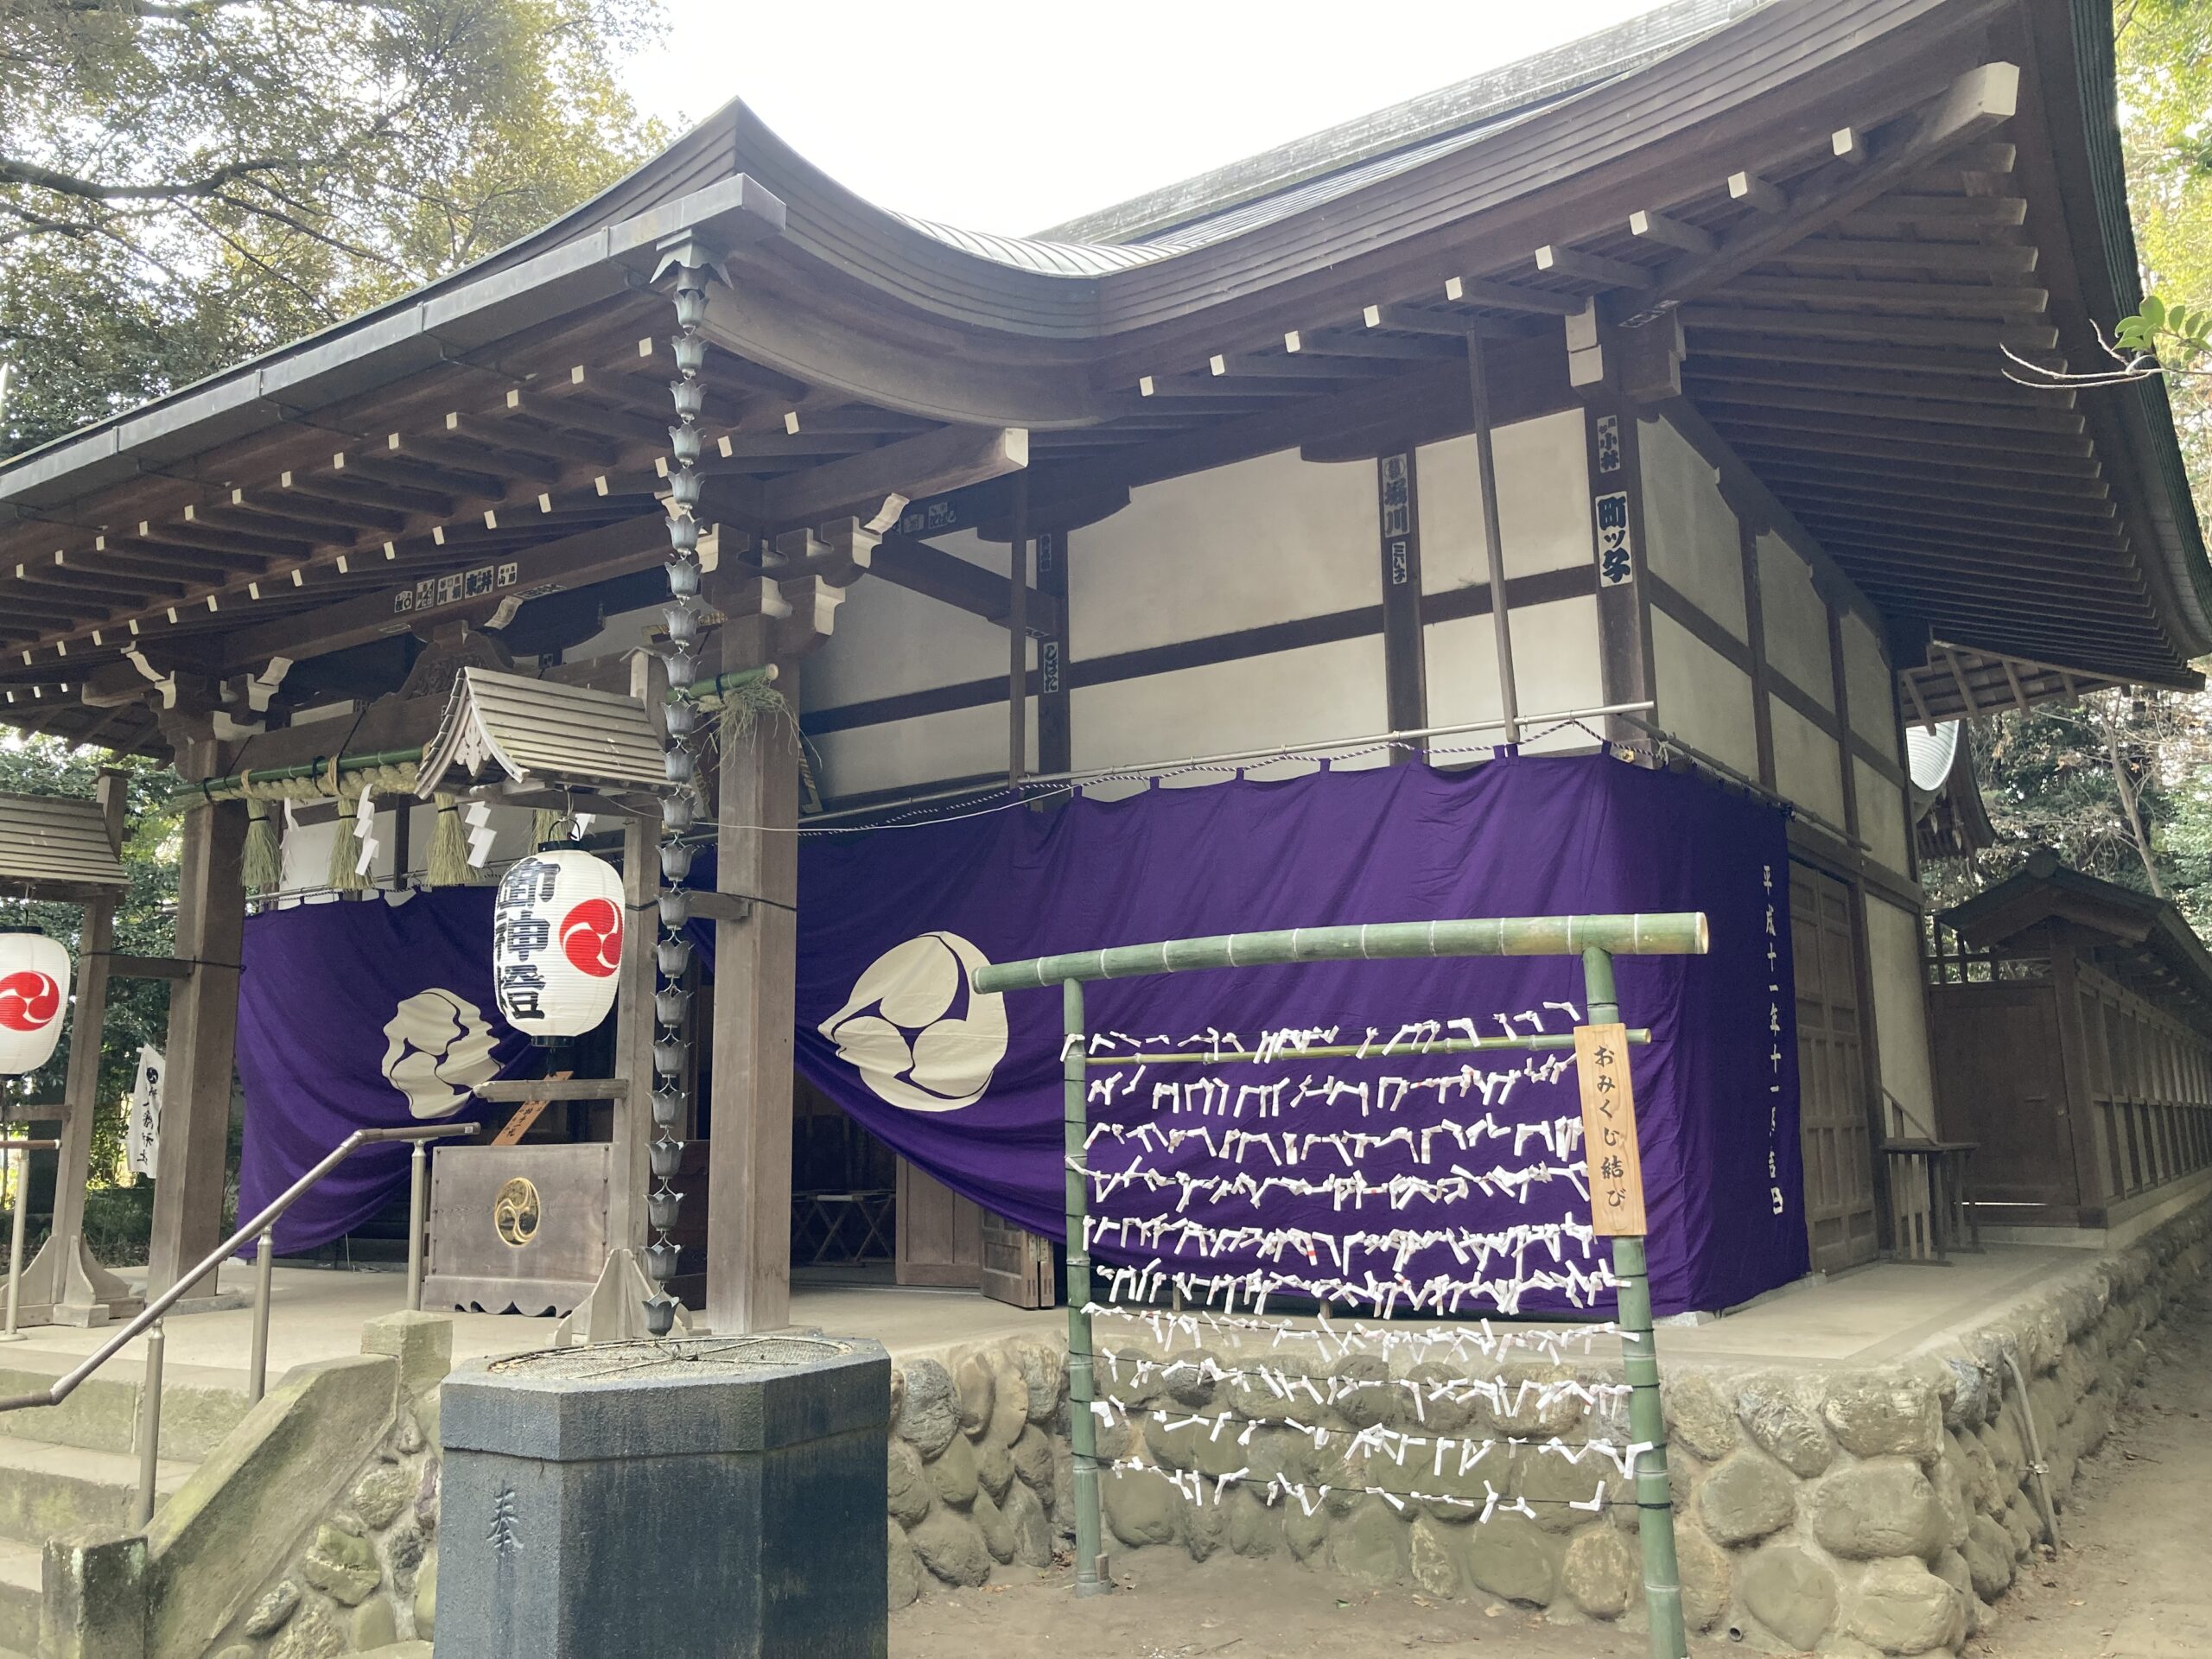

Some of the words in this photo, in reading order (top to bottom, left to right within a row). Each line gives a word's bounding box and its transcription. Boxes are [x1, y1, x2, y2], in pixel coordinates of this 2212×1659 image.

[1597, 495, 1631, 583] 町ッ子
[1593, 1045, 1626, 1207] おみくじ結び
